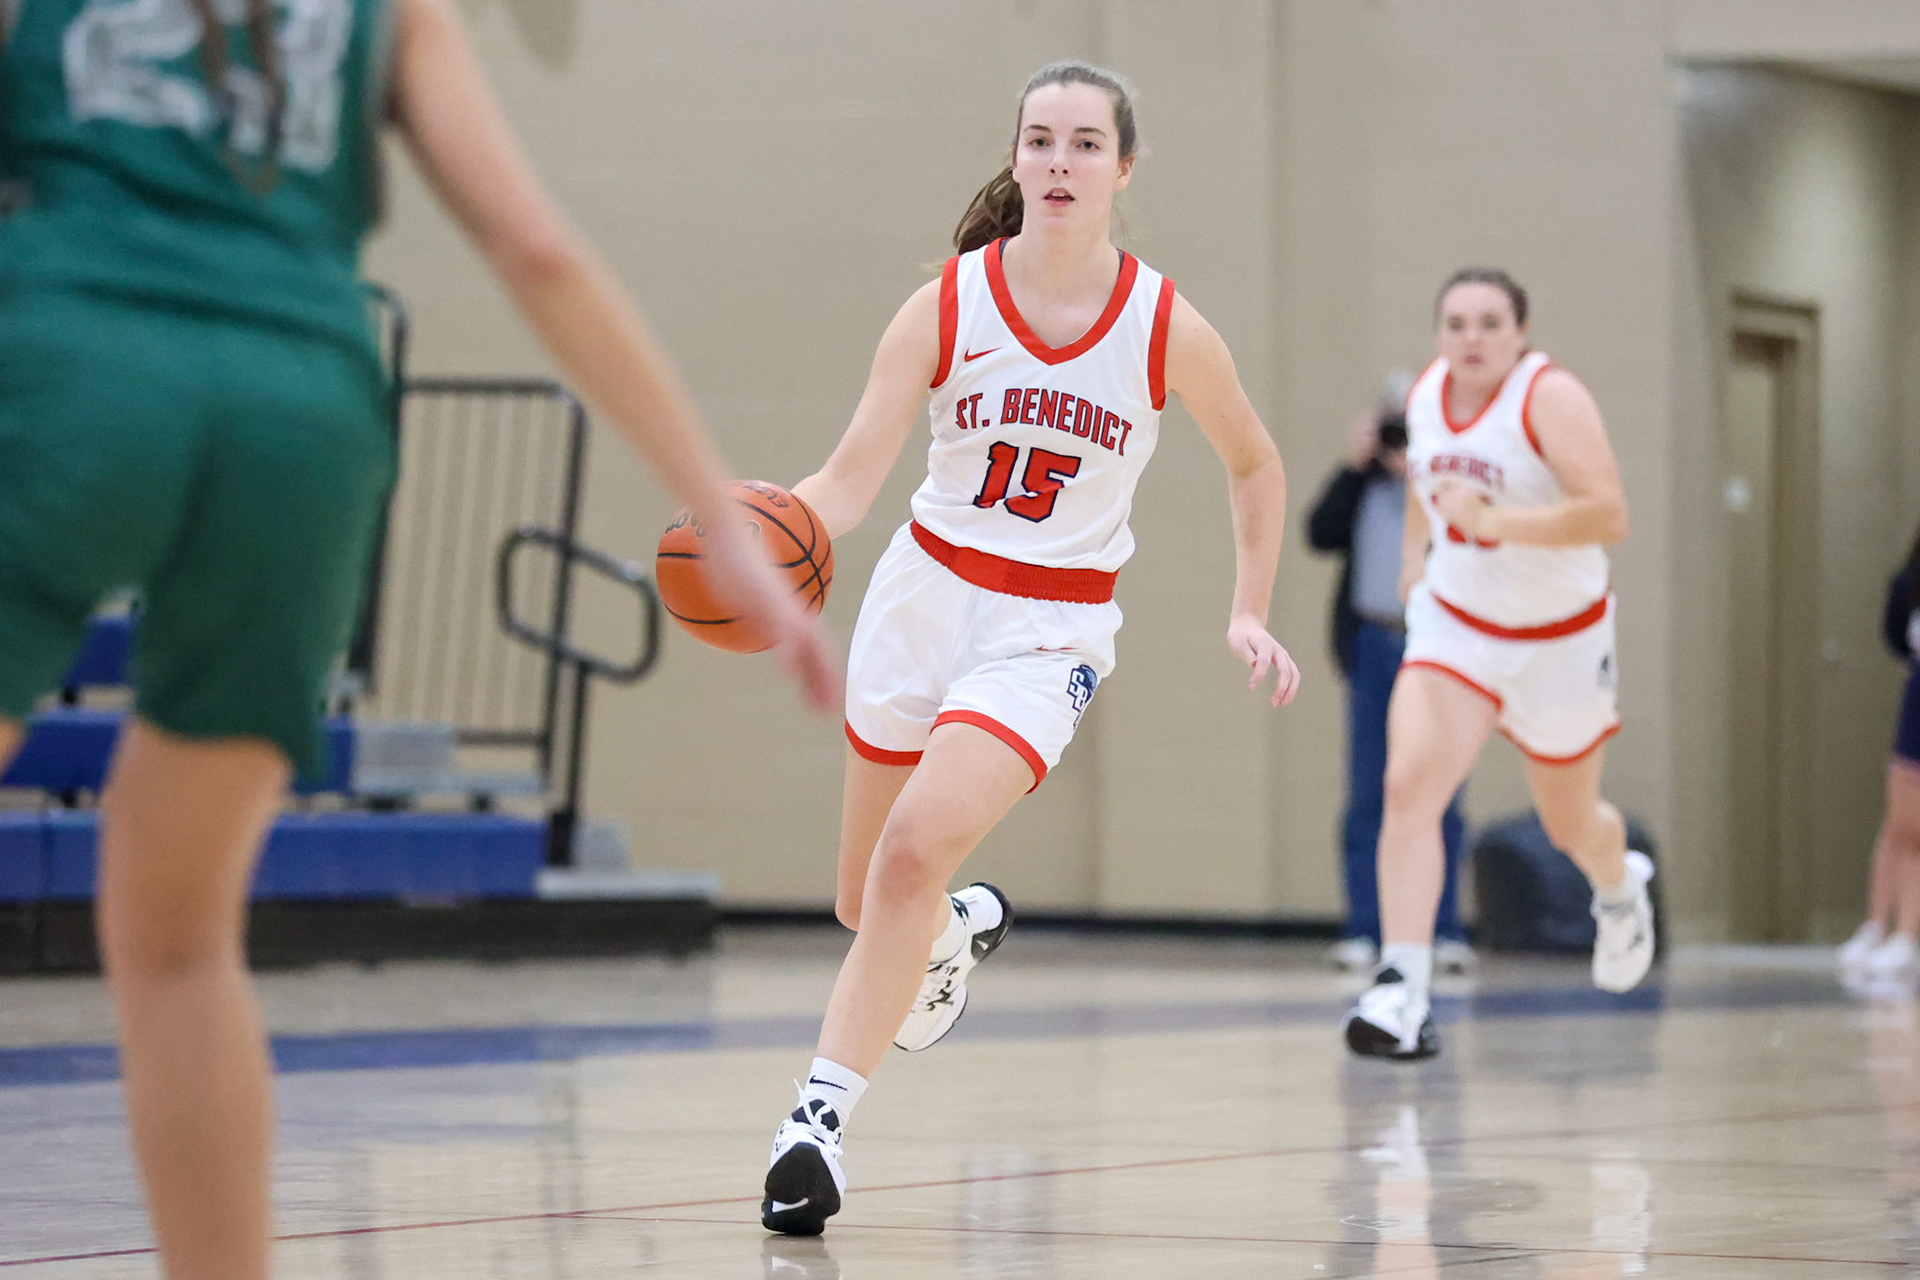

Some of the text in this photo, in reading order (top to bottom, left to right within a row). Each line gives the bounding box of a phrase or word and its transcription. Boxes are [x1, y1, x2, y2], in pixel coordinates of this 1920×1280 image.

[955, 388, 1132, 457] ST. BENEDICT
[972, 440, 1082, 523] 15
